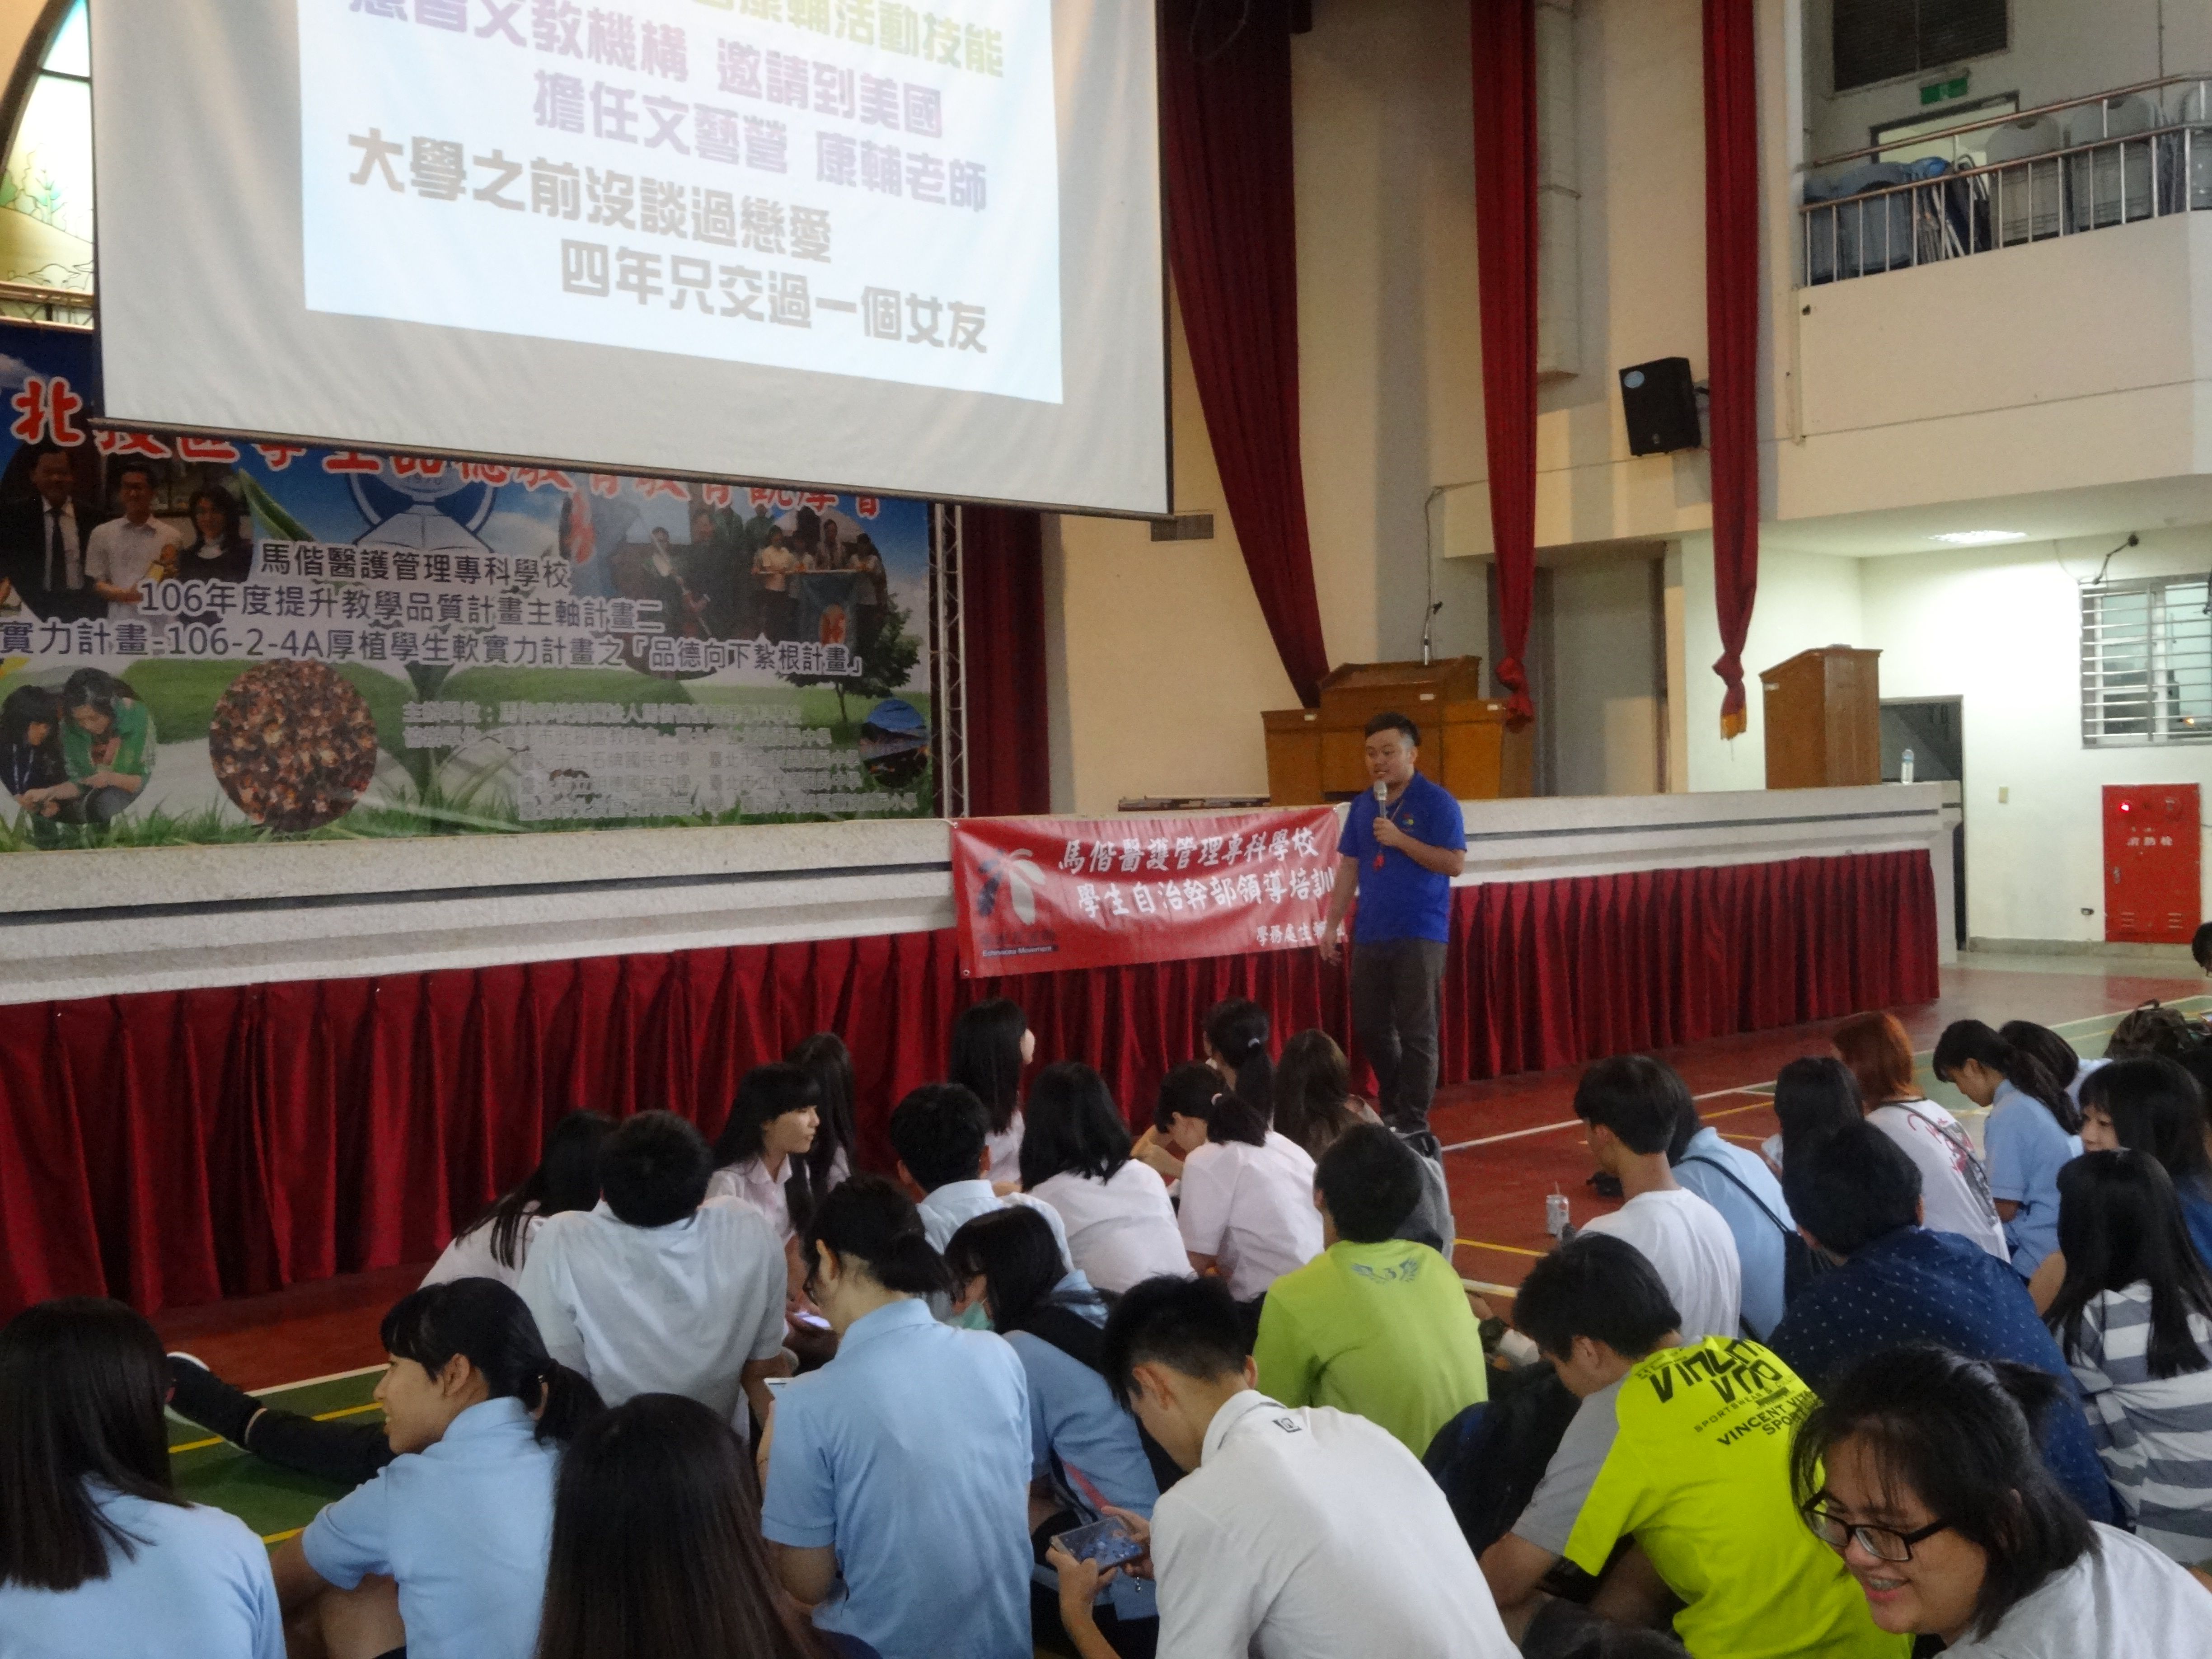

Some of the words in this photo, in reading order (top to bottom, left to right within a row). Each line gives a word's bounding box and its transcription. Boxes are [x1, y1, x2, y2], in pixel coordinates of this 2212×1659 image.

[717, 37, 943, 139] 邀請到美國
[533, 69, 787, 175] 擔任文藝營
[815, 130, 987, 213] 康輔老師
[561, 239, 988, 354] 四年只交過一個女友
[261, 543, 570, 589] 馬偕醫護管理專科學校
[1077, 866, 1360, 919] 學生自治幹部領導培訓
[1716, 1404, 1787, 1445] VINCENT
